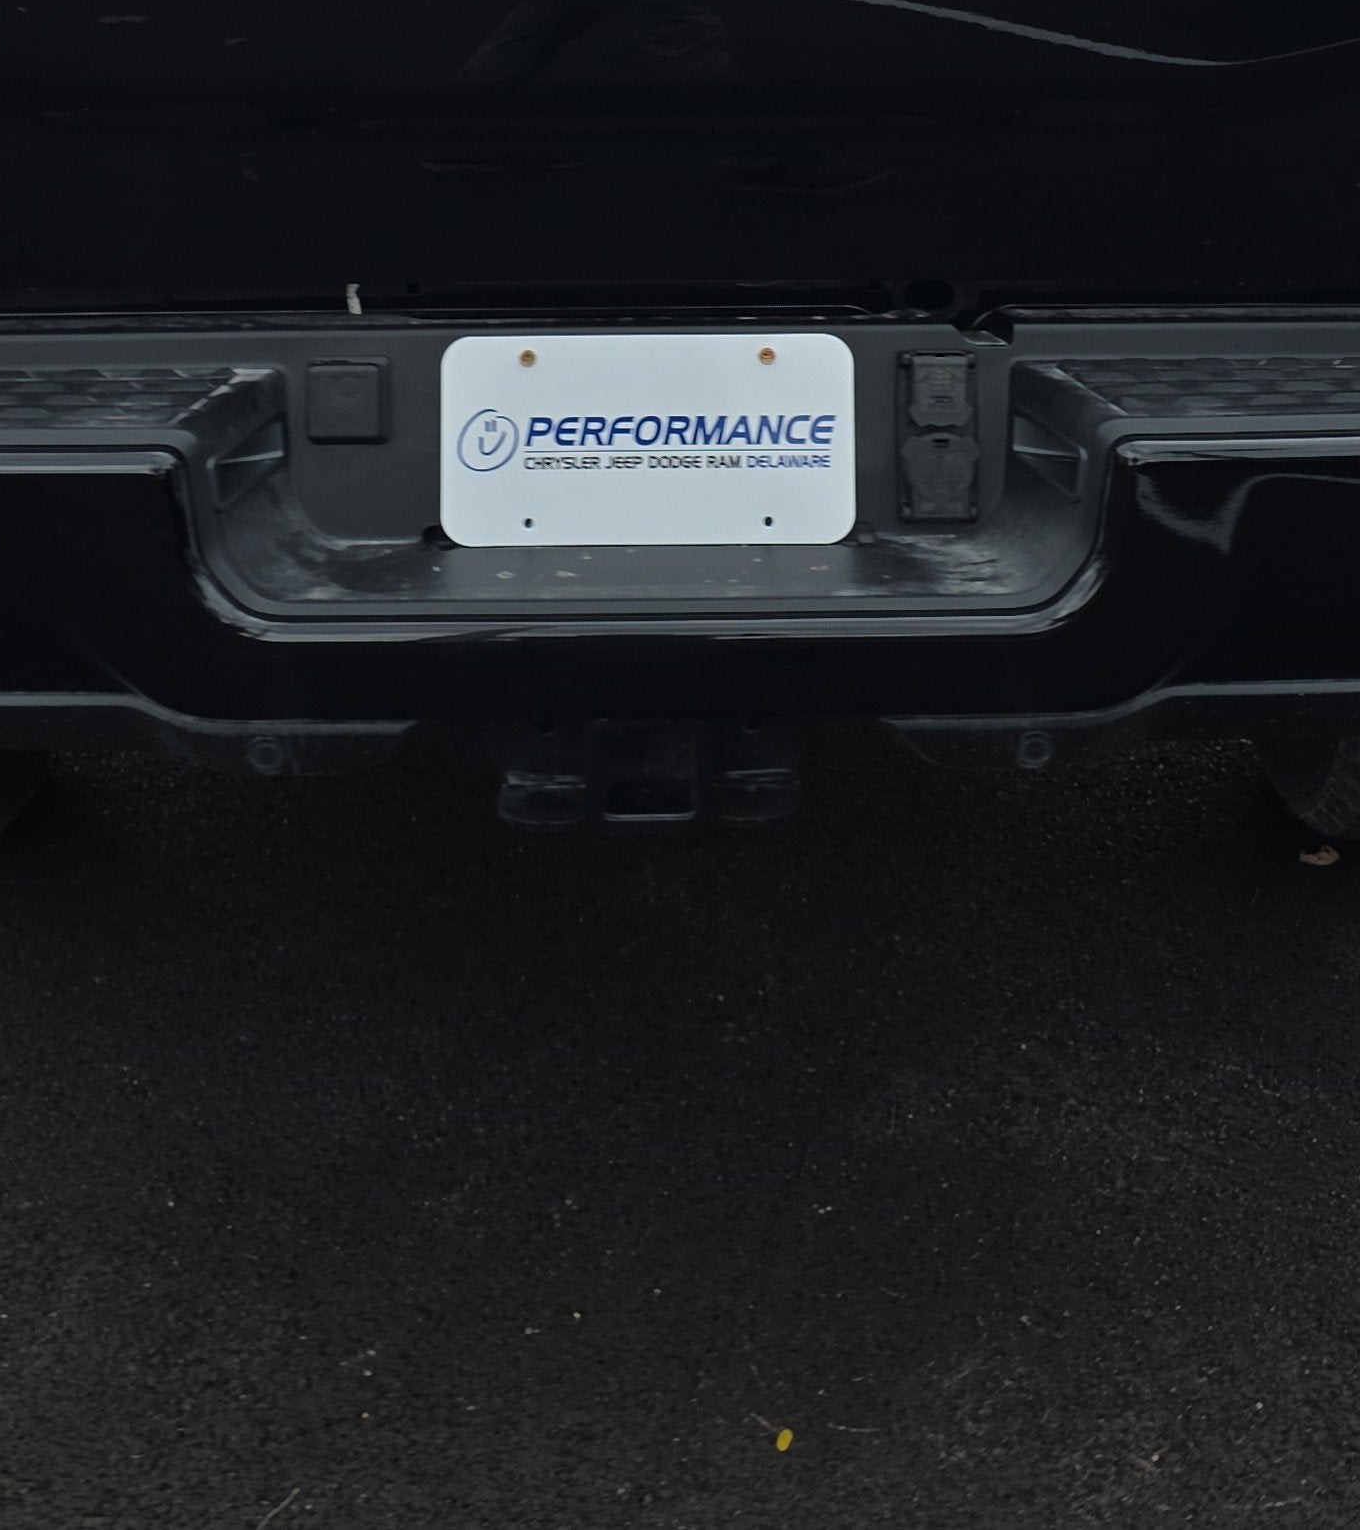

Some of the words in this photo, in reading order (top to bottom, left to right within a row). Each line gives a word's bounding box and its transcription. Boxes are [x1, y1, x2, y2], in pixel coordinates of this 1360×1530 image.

[524, 414, 837, 447] PERFORMANCE
[524, 456, 601, 470] CHRYSLER
[604, 455, 643, 469] JEEP
[648, 455, 703, 469] DODGE
[706, 455, 742, 469] RAM
[746, 454, 832, 468] DELAWARE
